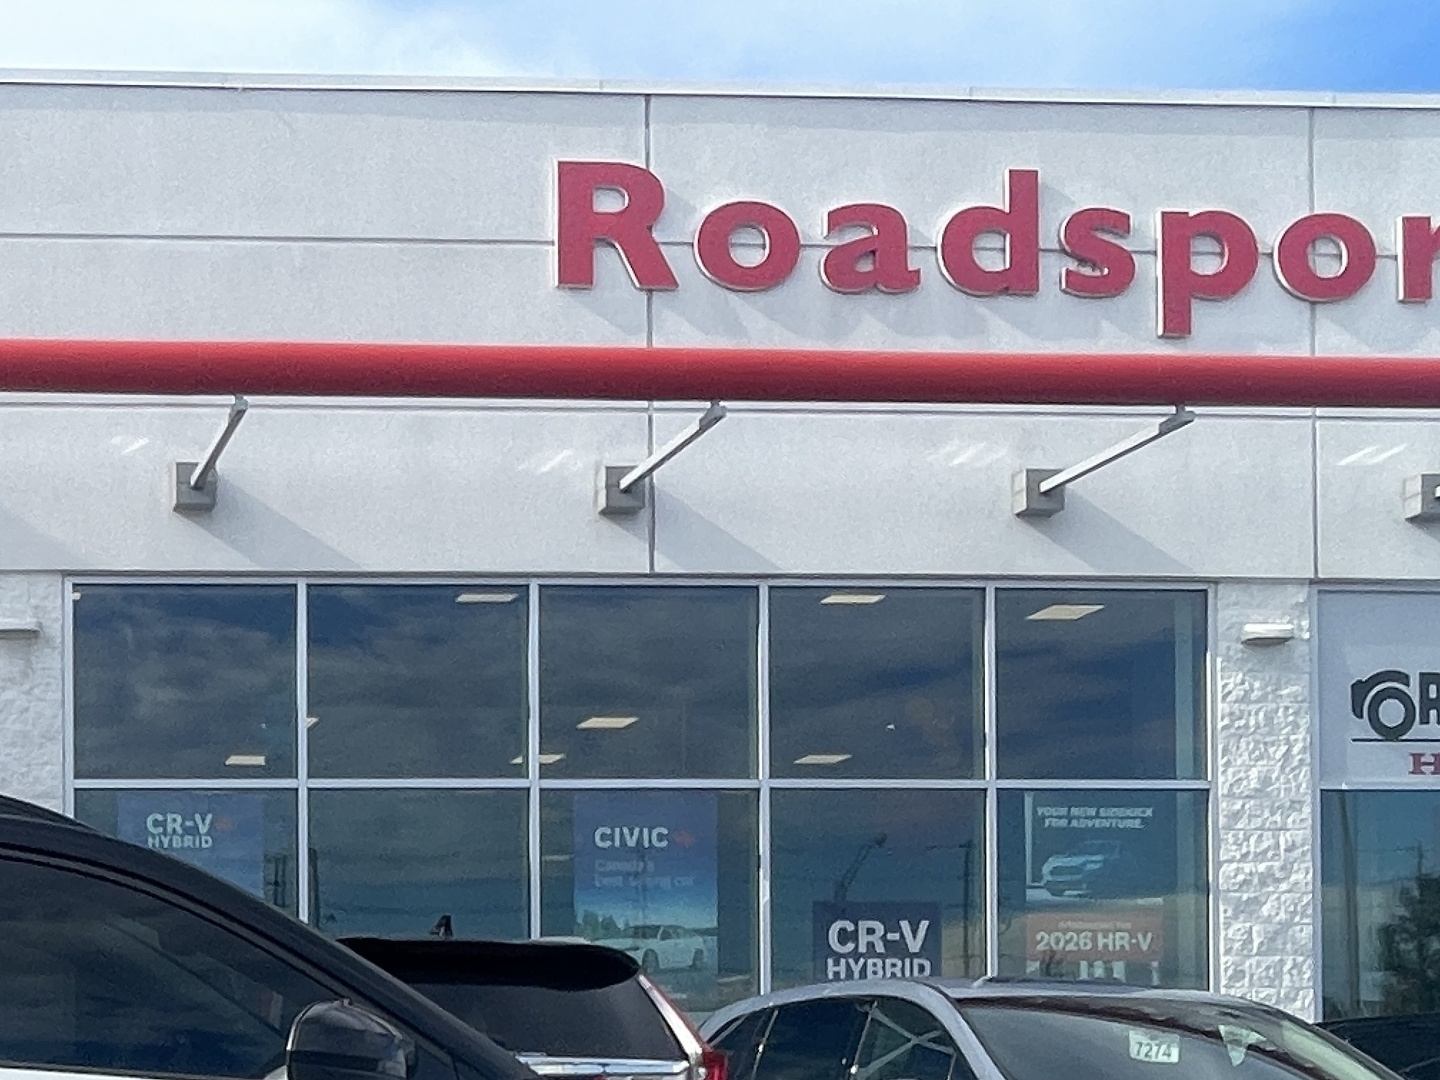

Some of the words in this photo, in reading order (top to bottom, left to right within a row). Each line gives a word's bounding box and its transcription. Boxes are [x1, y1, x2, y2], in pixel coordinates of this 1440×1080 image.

[146, 812, 213, 834] CR-V
[147, 834, 213, 849] HYBRID
[594, 826, 669, 849] CIVIC
[828, 919, 930, 954] CR-V
[1035, 930, 1093, 952] 2026
[1097, 930, 1153, 952] HR-V
[826, 957, 932, 980] HYBRID
[1135, 1041, 1172, 1060] 7274
